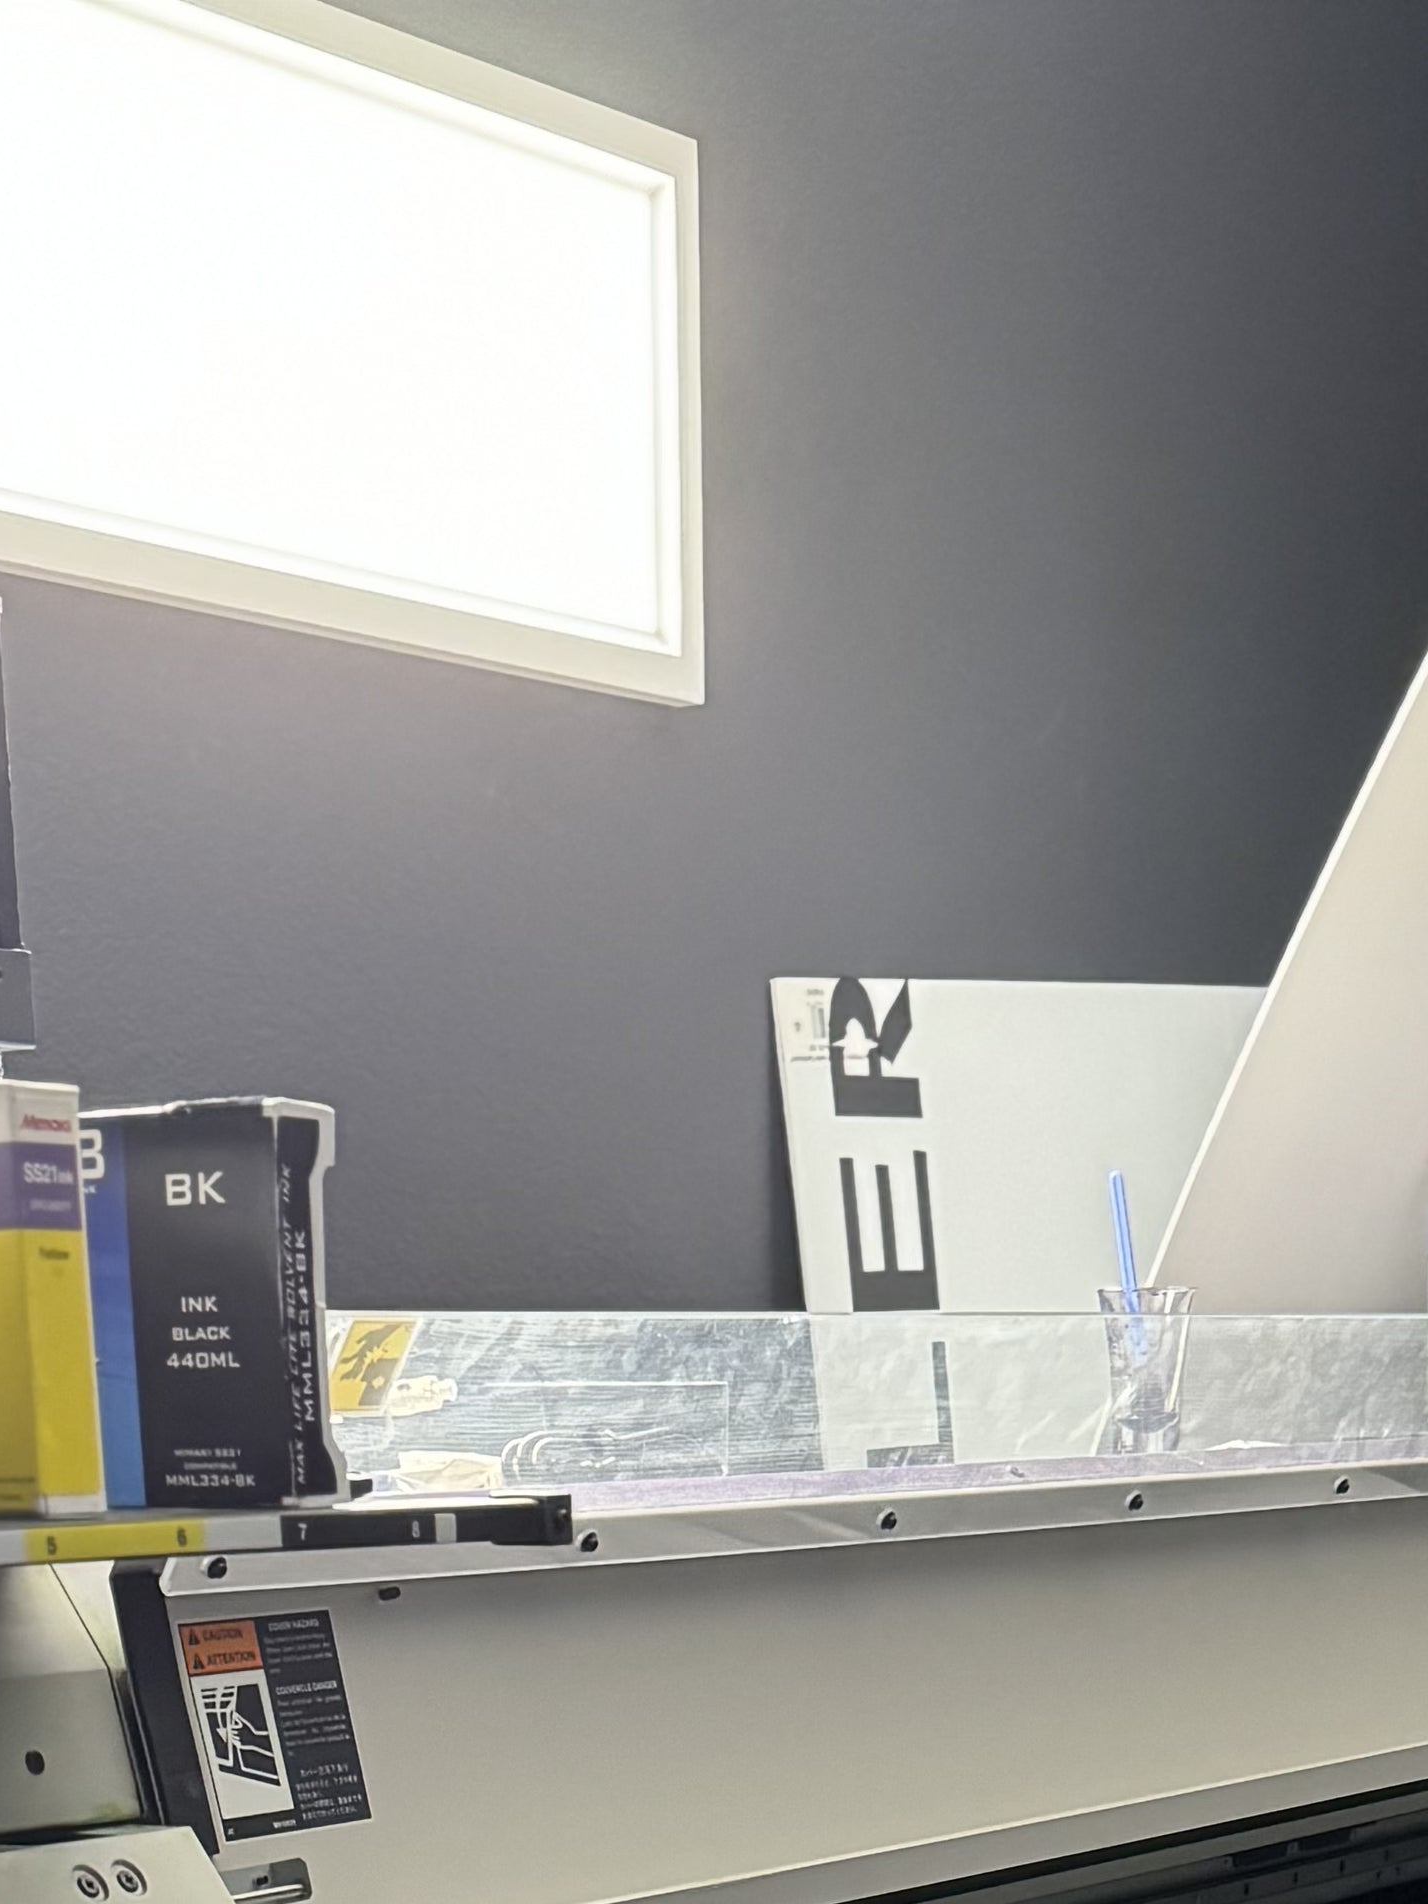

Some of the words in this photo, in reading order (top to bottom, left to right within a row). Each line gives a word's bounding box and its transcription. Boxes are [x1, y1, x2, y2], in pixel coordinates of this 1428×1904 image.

[165, 1171, 226, 1206] BK
[280, 1163, 292, 1203] INK
[180, 1296, 218, 1313] INK
[172, 1325, 232, 1342] BLACK
[294, 1230, 315, 1422] MML334-BK
[166, 1352, 240, 1369] 440ML
[165, 1474, 256, 1488] MML334-BK
[176, 1528, 187, 1547] 6
[298, 1523, 308, 1541] 7
[411, 1520, 422, 1539] 8
[46, 1536, 57, 1555] 5
[206, 1650, 256, 1667] ATTENTION
